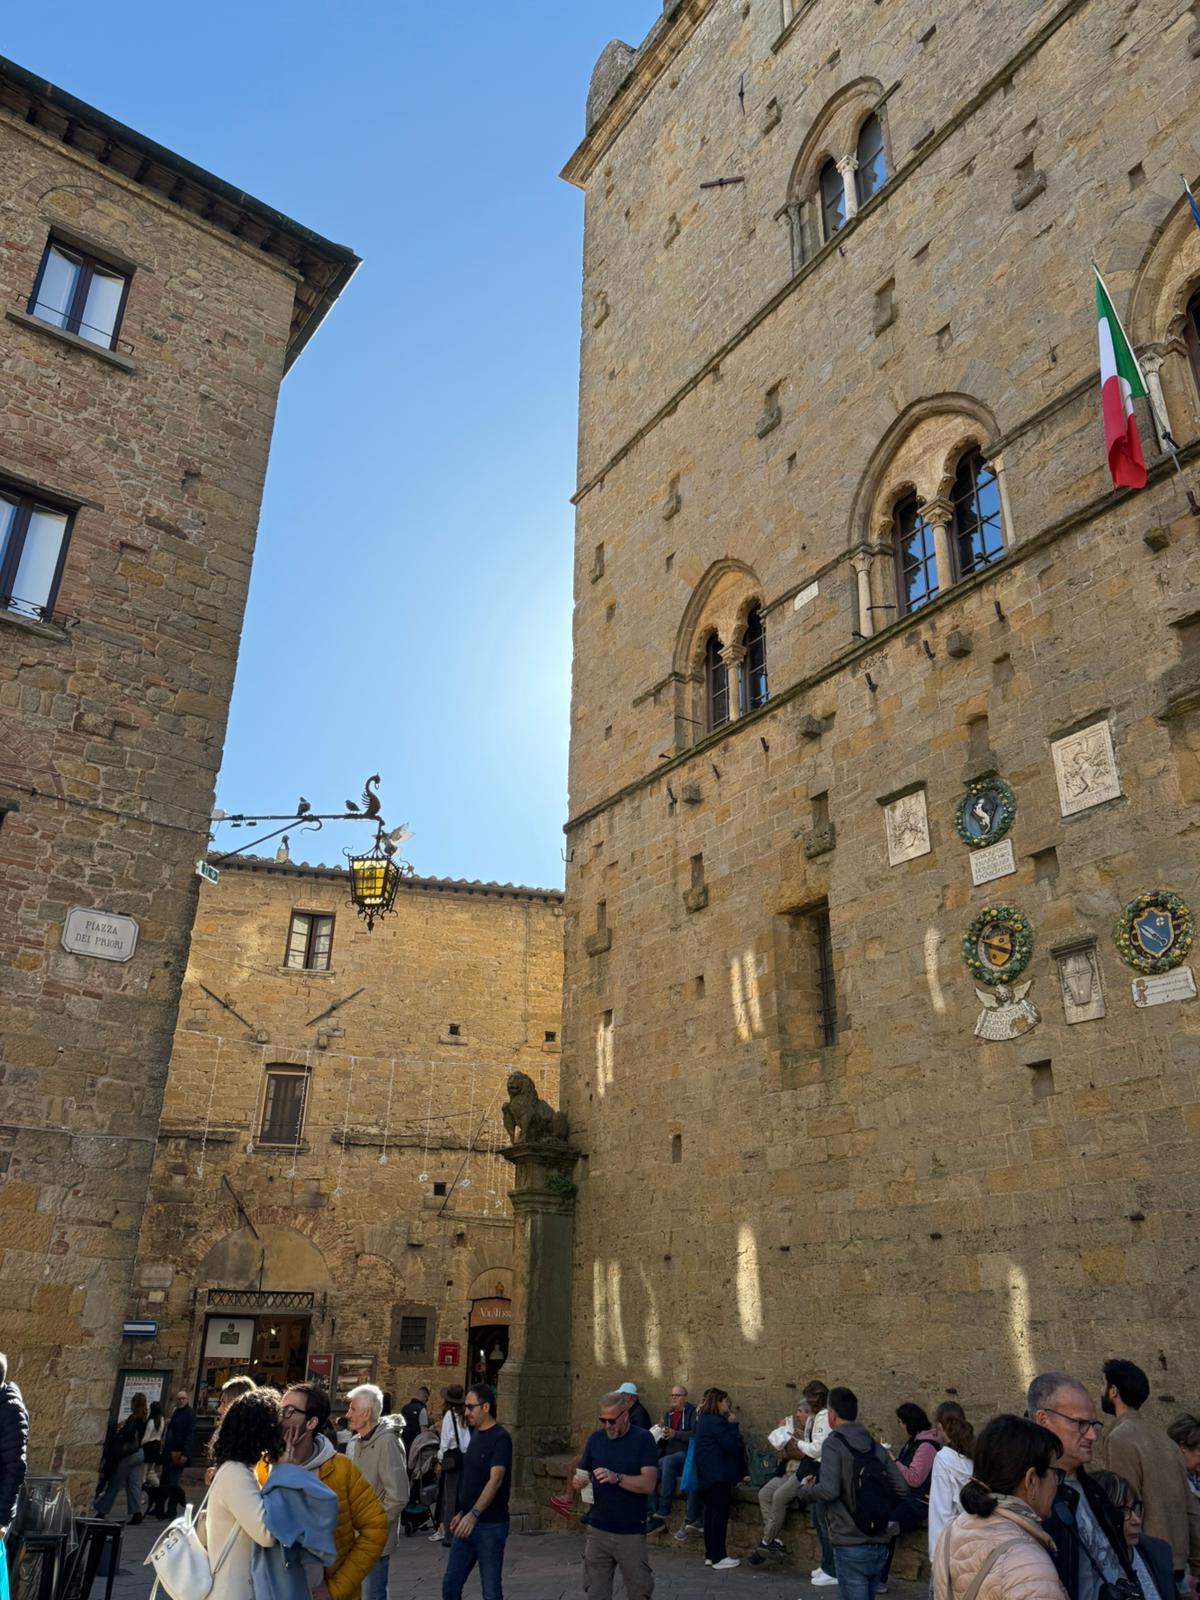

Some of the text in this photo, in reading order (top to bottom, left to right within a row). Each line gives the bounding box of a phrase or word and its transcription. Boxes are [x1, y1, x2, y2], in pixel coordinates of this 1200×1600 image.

[85, 921, 118, 935] PIAZZA
[75, 933, 124, 950] DEI PRIORI
